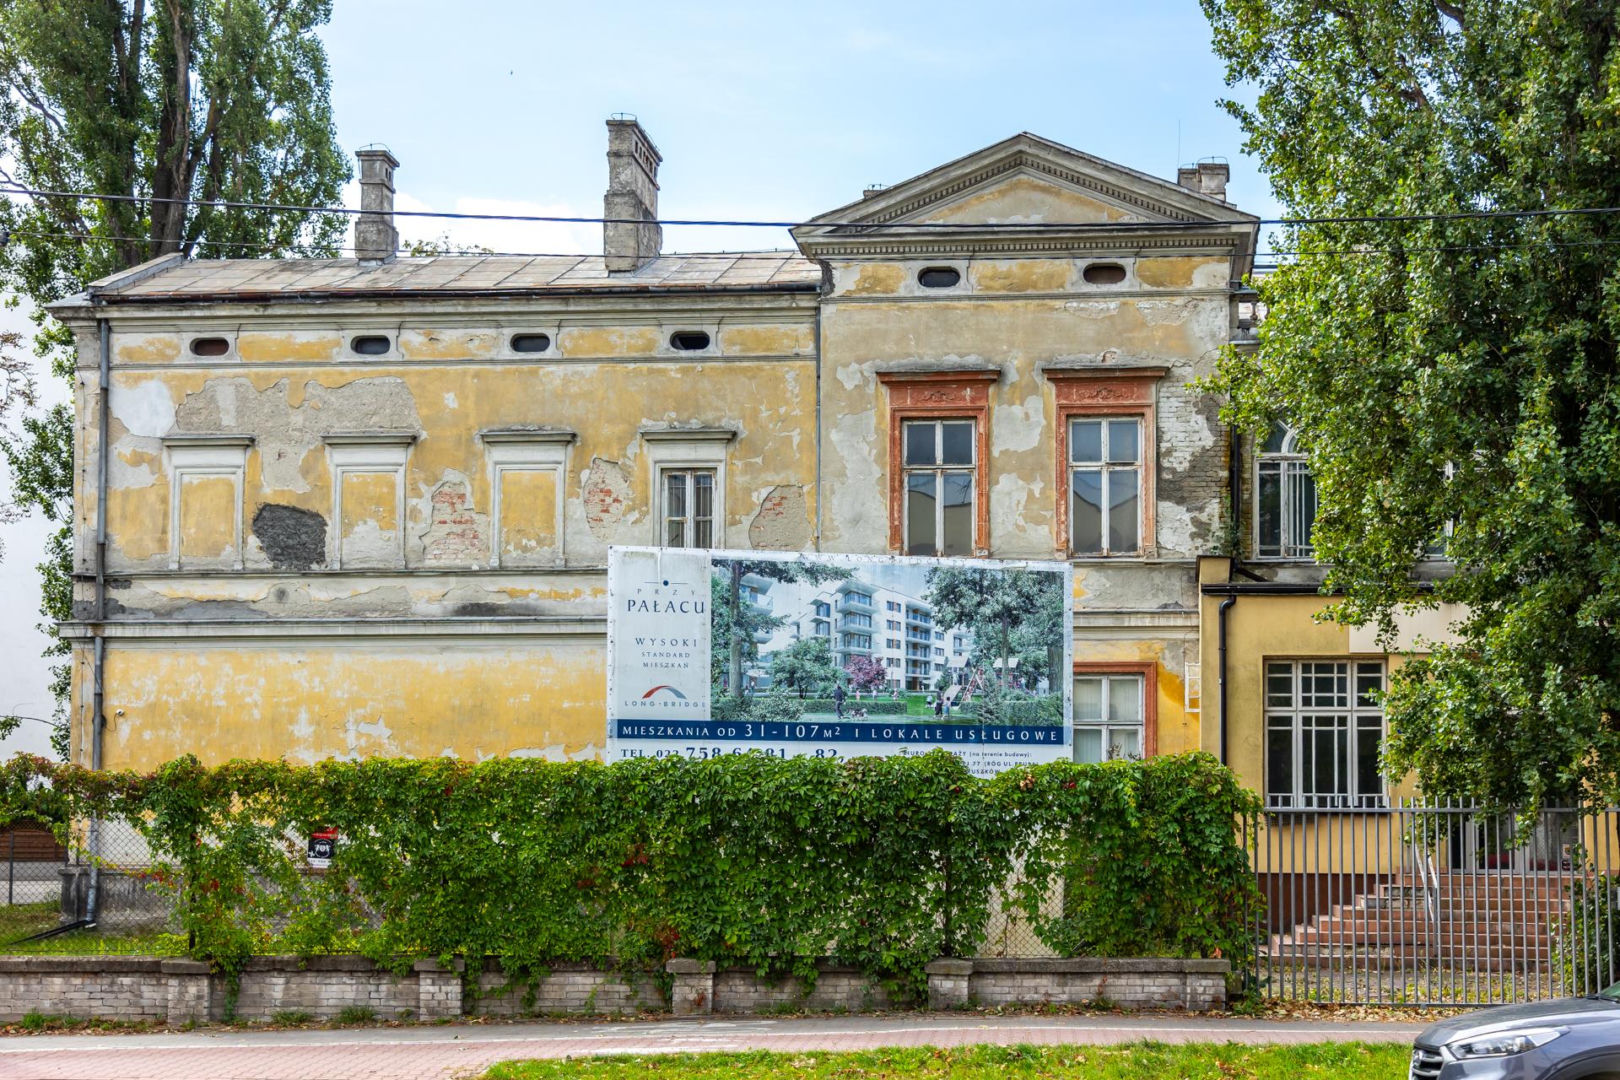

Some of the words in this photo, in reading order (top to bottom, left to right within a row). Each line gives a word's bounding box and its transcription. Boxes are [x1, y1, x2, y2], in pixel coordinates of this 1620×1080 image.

[637, 588, 695, 596] PRZY
[627, 599, 704, 614] PAŁACU
[635, 637, 697, 647] WYSOKI
[622, 725, 709, 736] MIESZKANIA
[717, 727, 736, 737] OD
[855, 729, 859, 738] I
[871, 729, 943, 739] LOKALE
[955, 730, 1057, 741] USŁUGOWE
[620, 749, 650, 758] TEL.
[686, 747, 721, 760] 758
